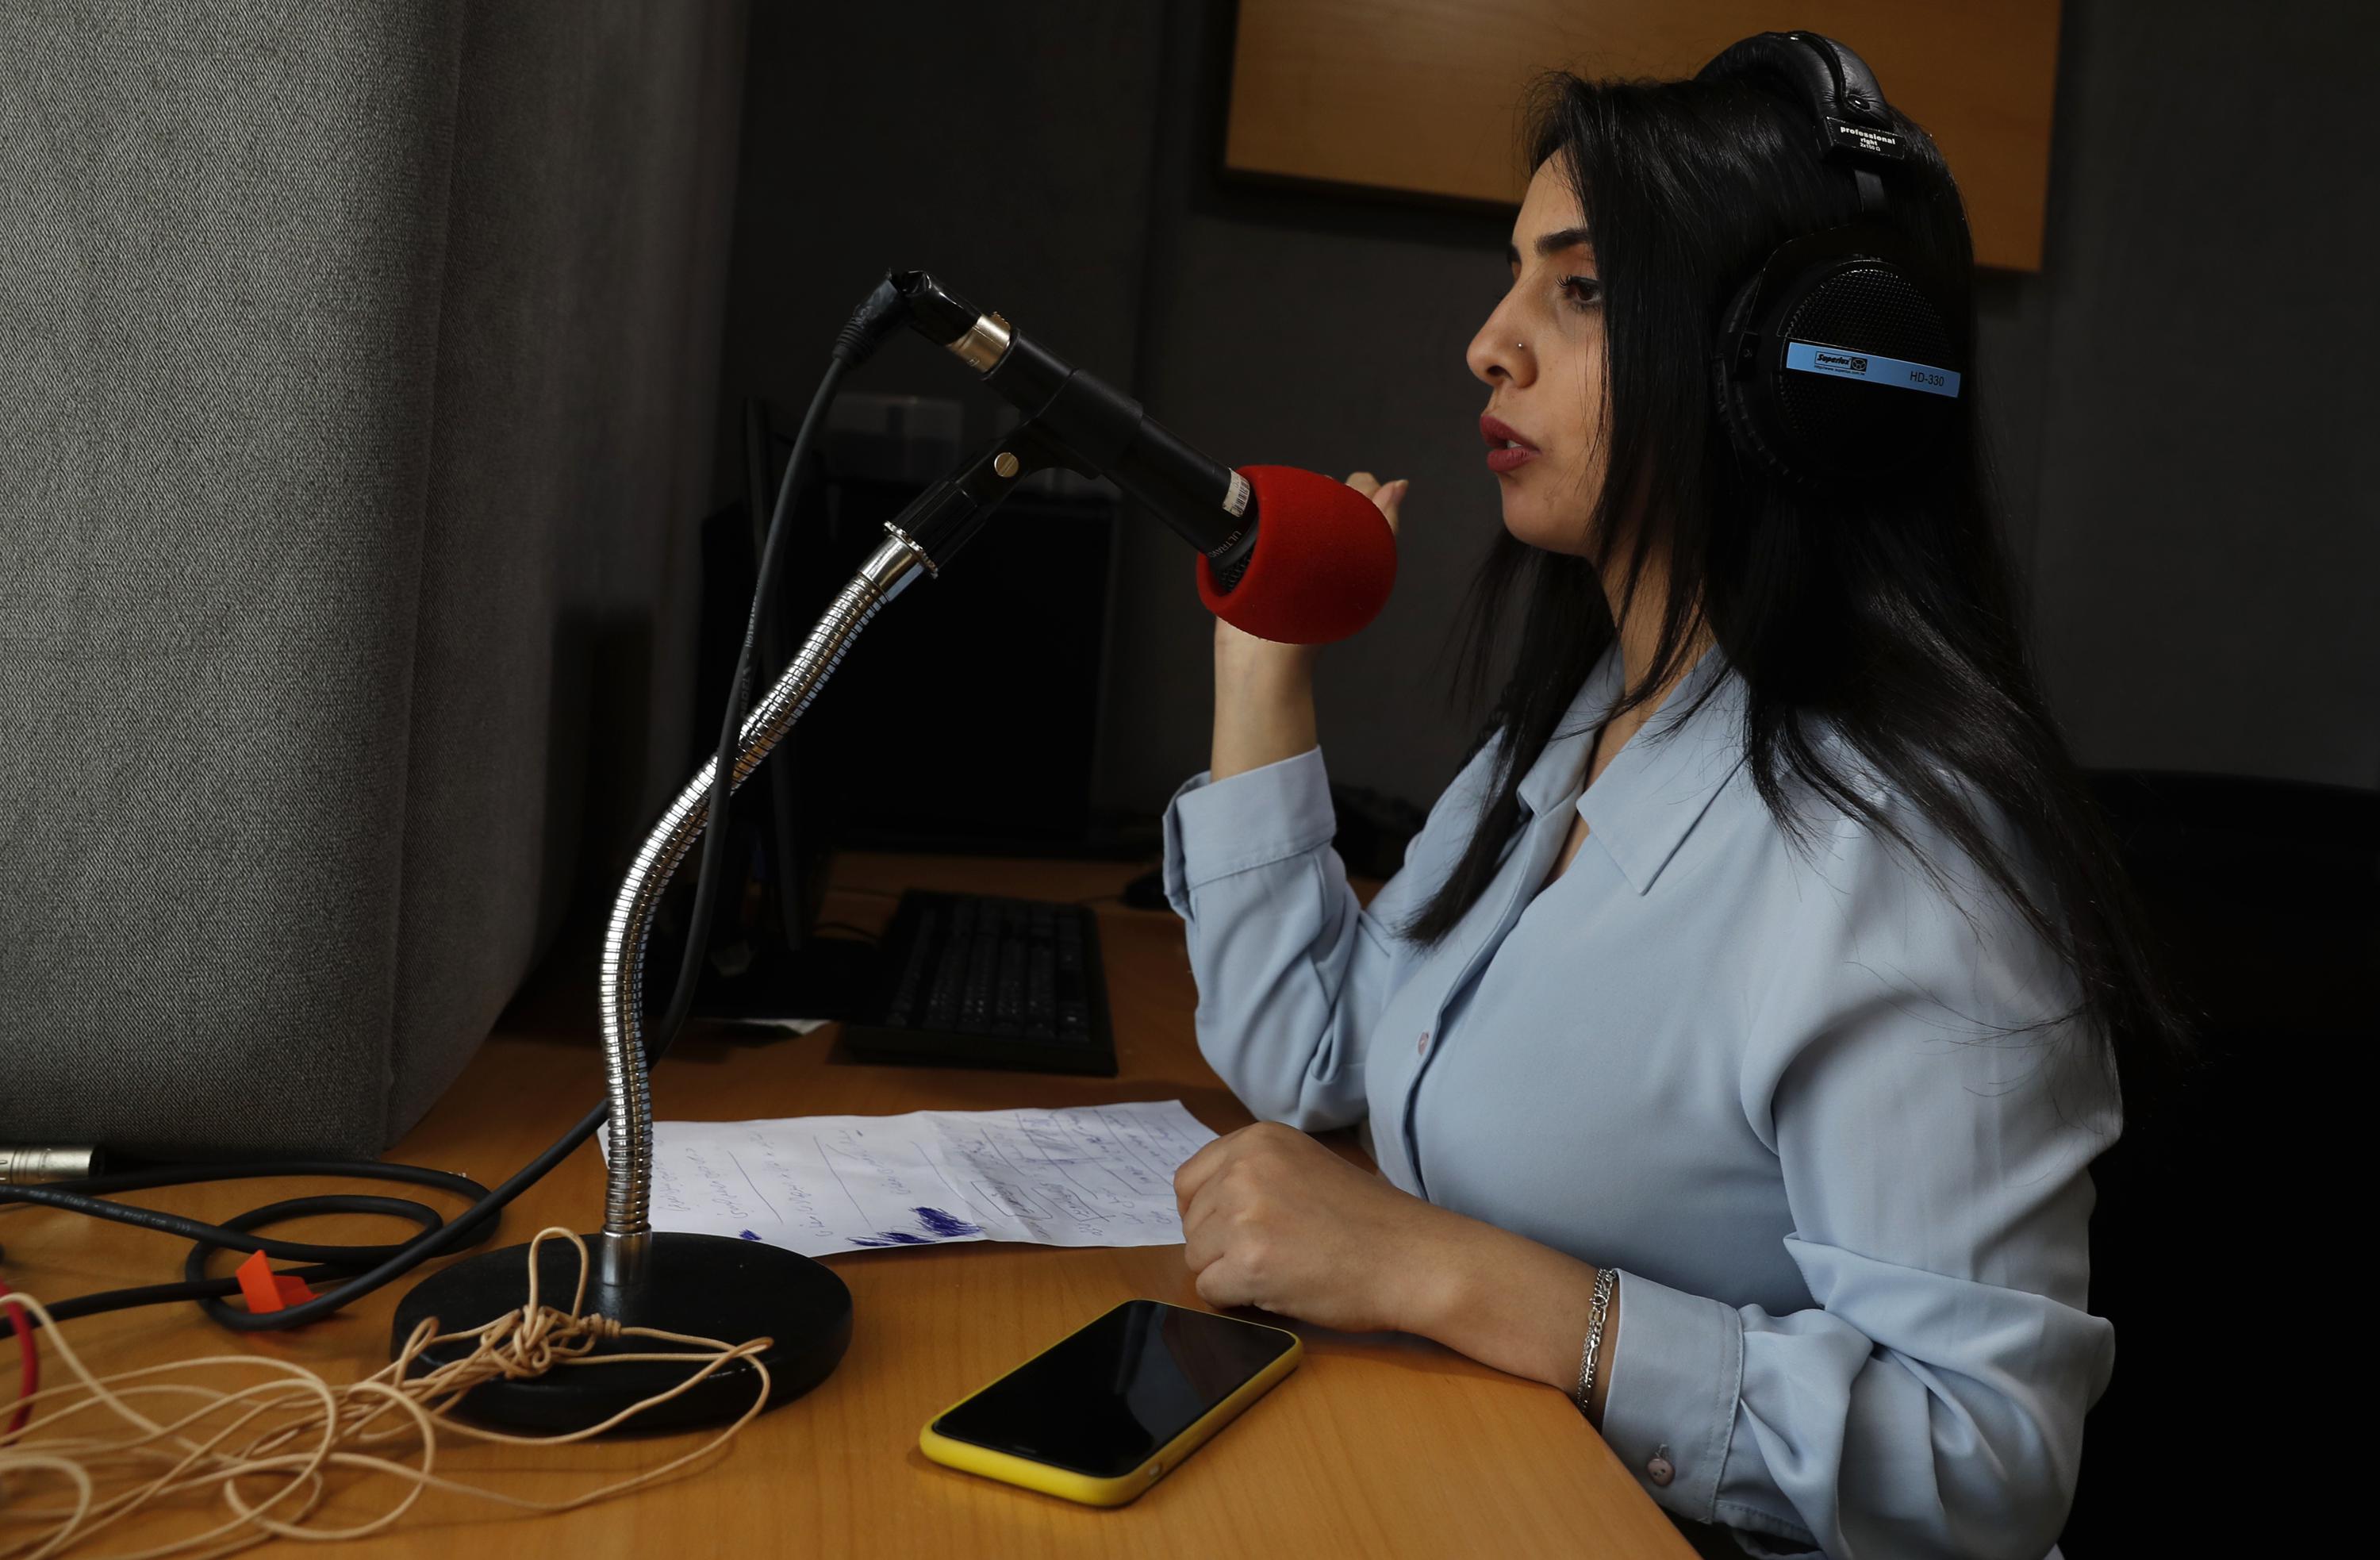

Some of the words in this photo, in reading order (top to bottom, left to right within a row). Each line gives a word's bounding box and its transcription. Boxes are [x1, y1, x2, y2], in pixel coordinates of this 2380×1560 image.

[1840, 126, 1896, 145] professional
[1860, 137, 1878, 146] right
[1817, 354, 1850, 365] Superlux
[1910, 371, 1944, 388] HD-330
